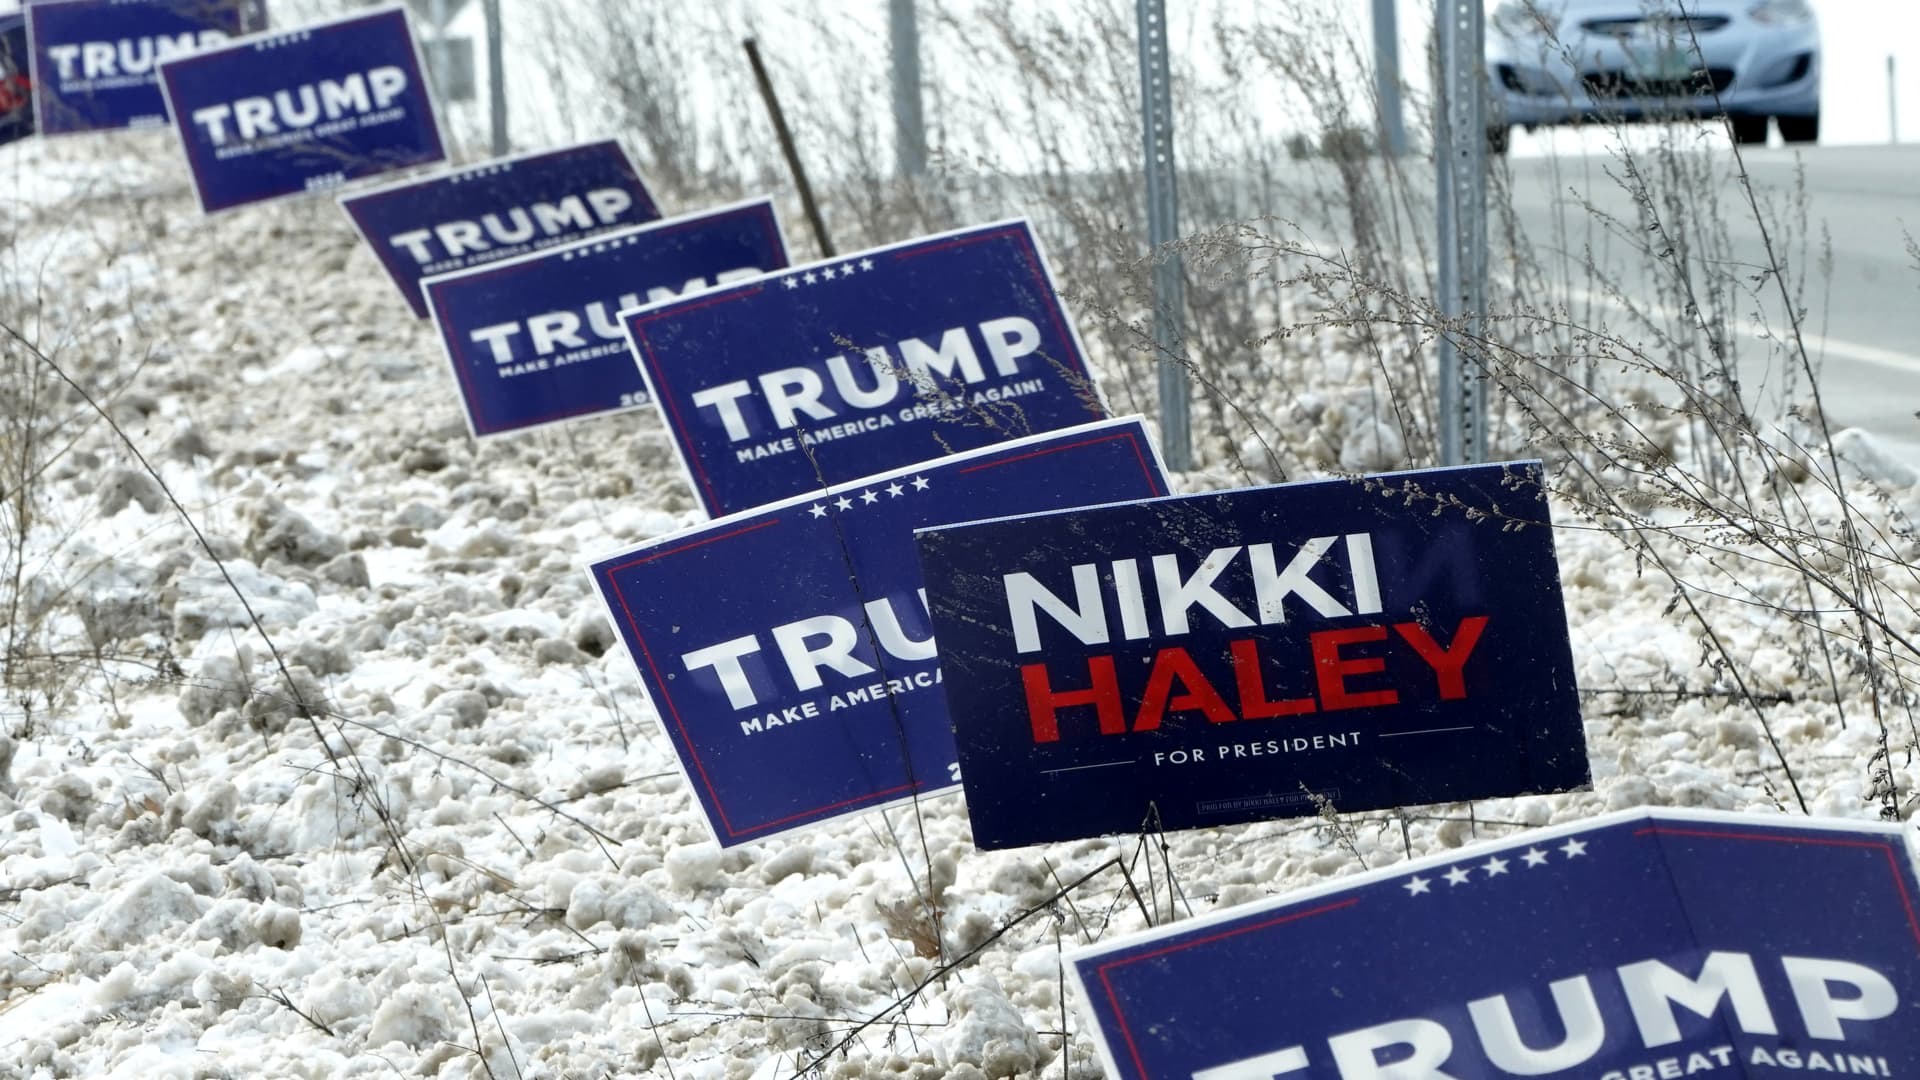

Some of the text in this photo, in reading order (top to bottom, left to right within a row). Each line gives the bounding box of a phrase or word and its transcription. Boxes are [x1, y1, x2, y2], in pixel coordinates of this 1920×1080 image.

[192, 65, 408, 146] TRUMP
[389, 187, 632, 264] TRUMP
[499, 358, 550, 378] MAKE
[620, 390, 648, 407] 20
[692, 315, 1042, 443] TRUMP
[736, 378, 1046, 464] MAKE AMERICA GREAT AGAIN!
[1003, 532, 1383, 654] NIKKI
[681, 588, 939, 711] TRU
[1020, 615, 1490, 744] HALEY
[740, 702, 820, 736] MAKE
[1154, 731, 1363, 767] FOR PRESIDENT
[1750, 1046, 1892, 1078] AGAIN!
